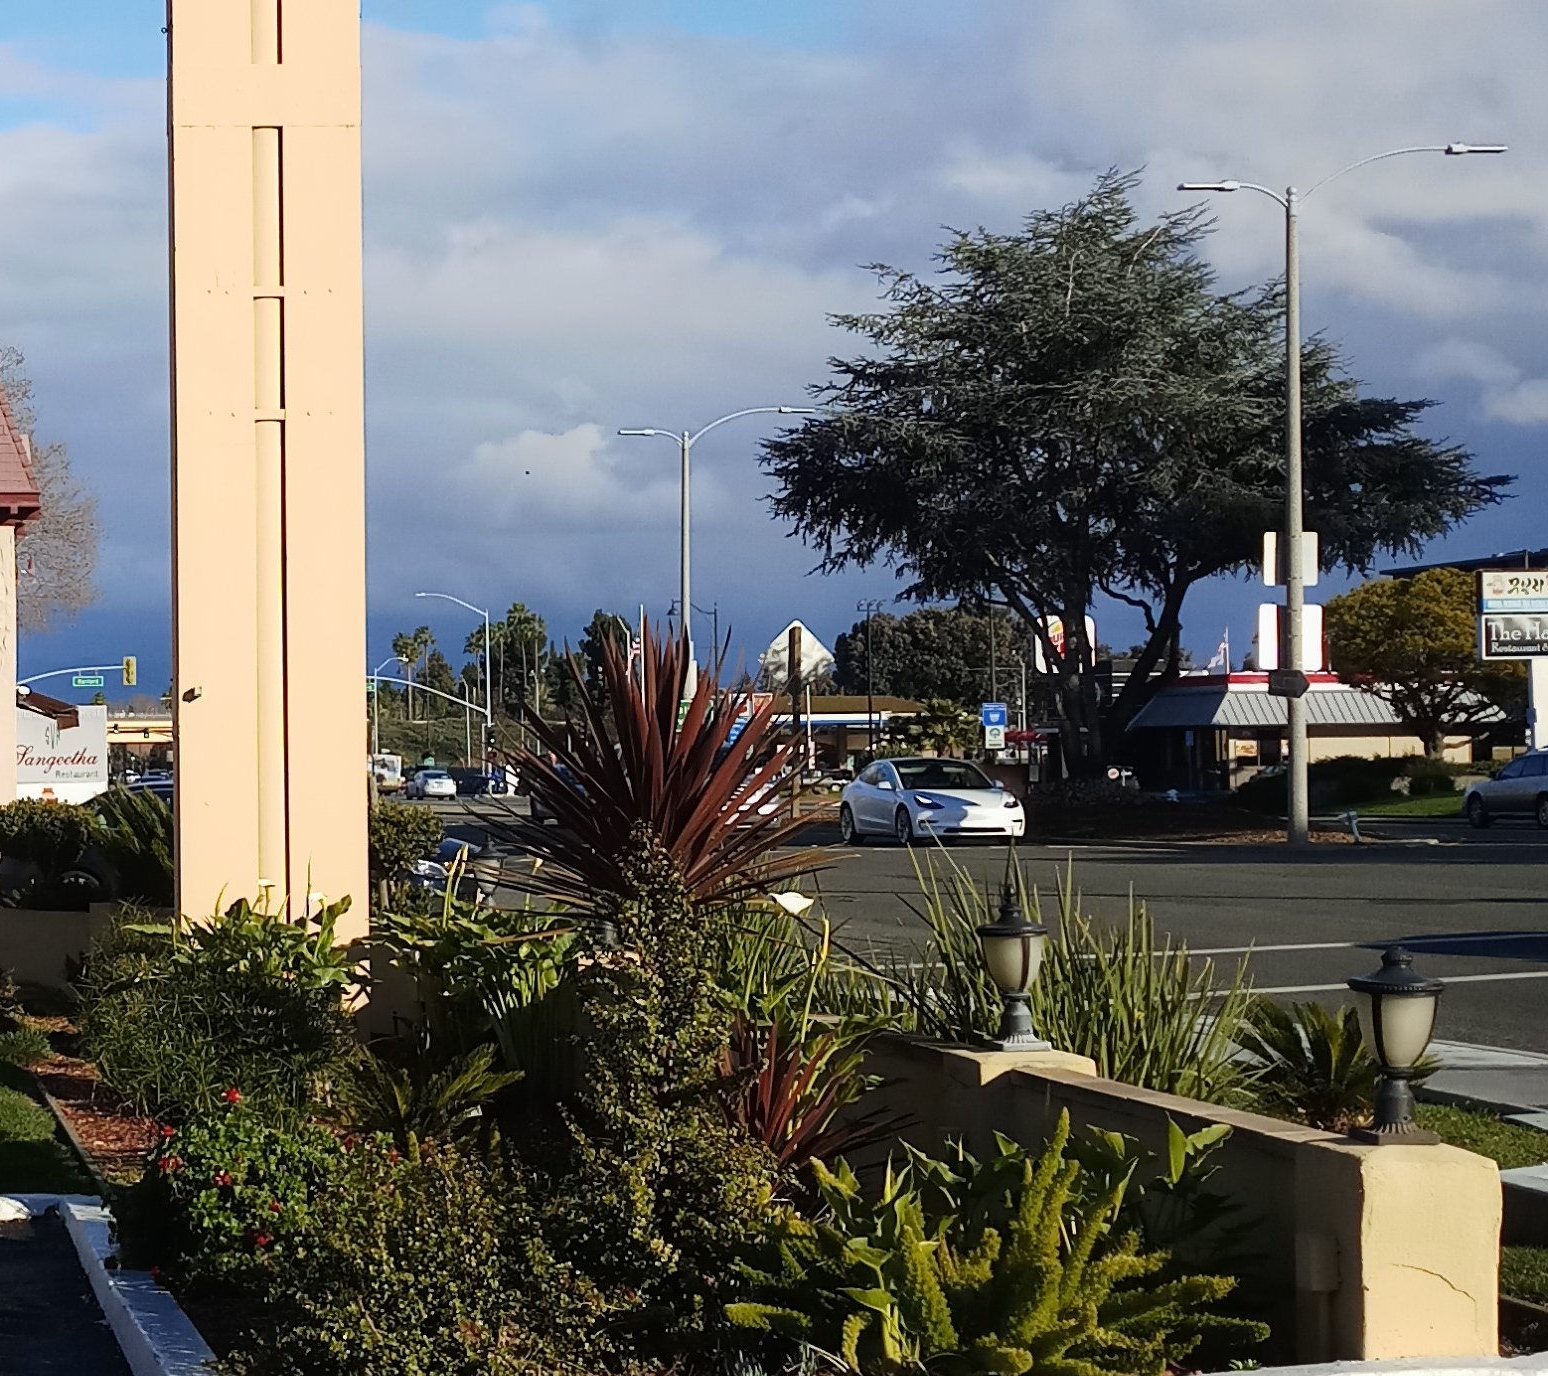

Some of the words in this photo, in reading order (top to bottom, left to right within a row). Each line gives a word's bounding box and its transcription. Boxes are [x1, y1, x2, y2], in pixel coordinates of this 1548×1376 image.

[1487, 621, 1522, 641] The
[1491, 642, 1541, 653] Restaurant
[16, 744, 98, 774] Sangeetha
[55, 769, 99, 779] Restaurant
